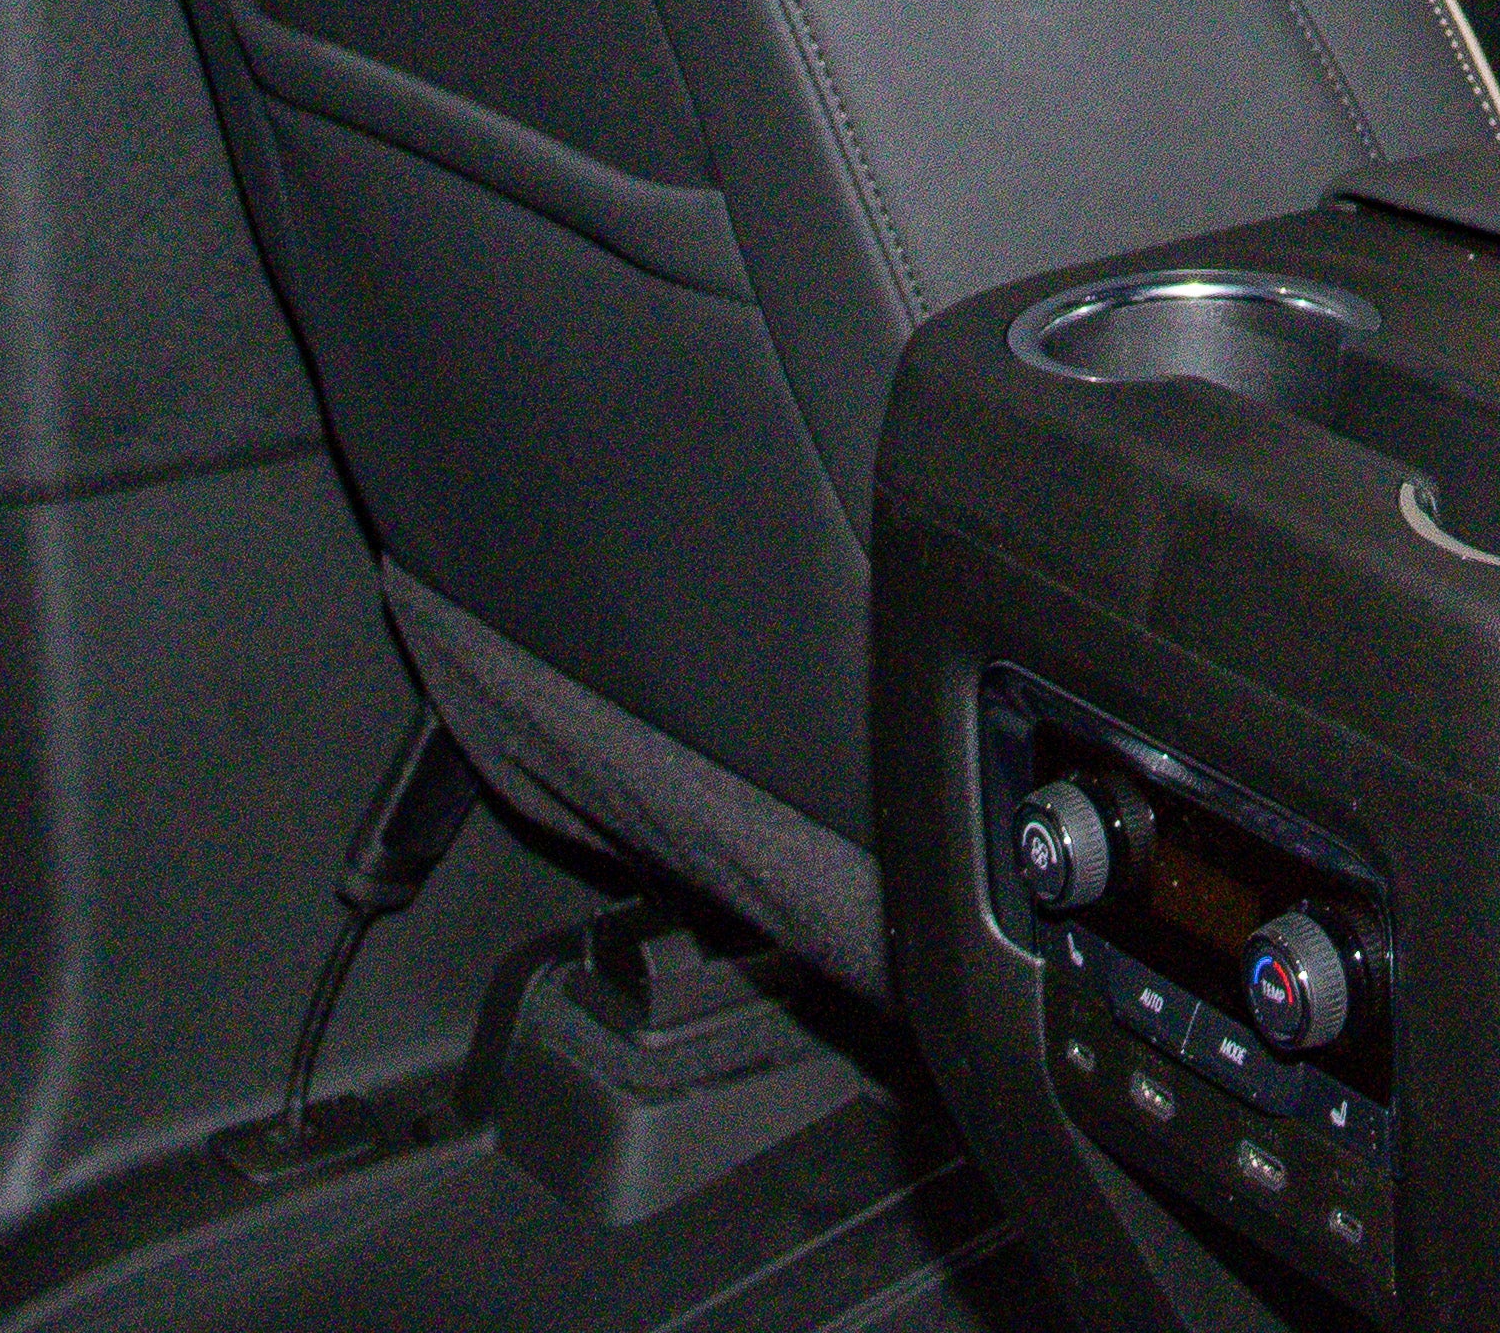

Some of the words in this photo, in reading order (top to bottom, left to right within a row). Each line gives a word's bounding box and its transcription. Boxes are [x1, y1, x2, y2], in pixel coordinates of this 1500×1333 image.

[1138, 987, 1164, 1014] AUTO
[1261, 977, 1286, 1004] TEMP
[1219, 1036, 1248, 1066] MODE
